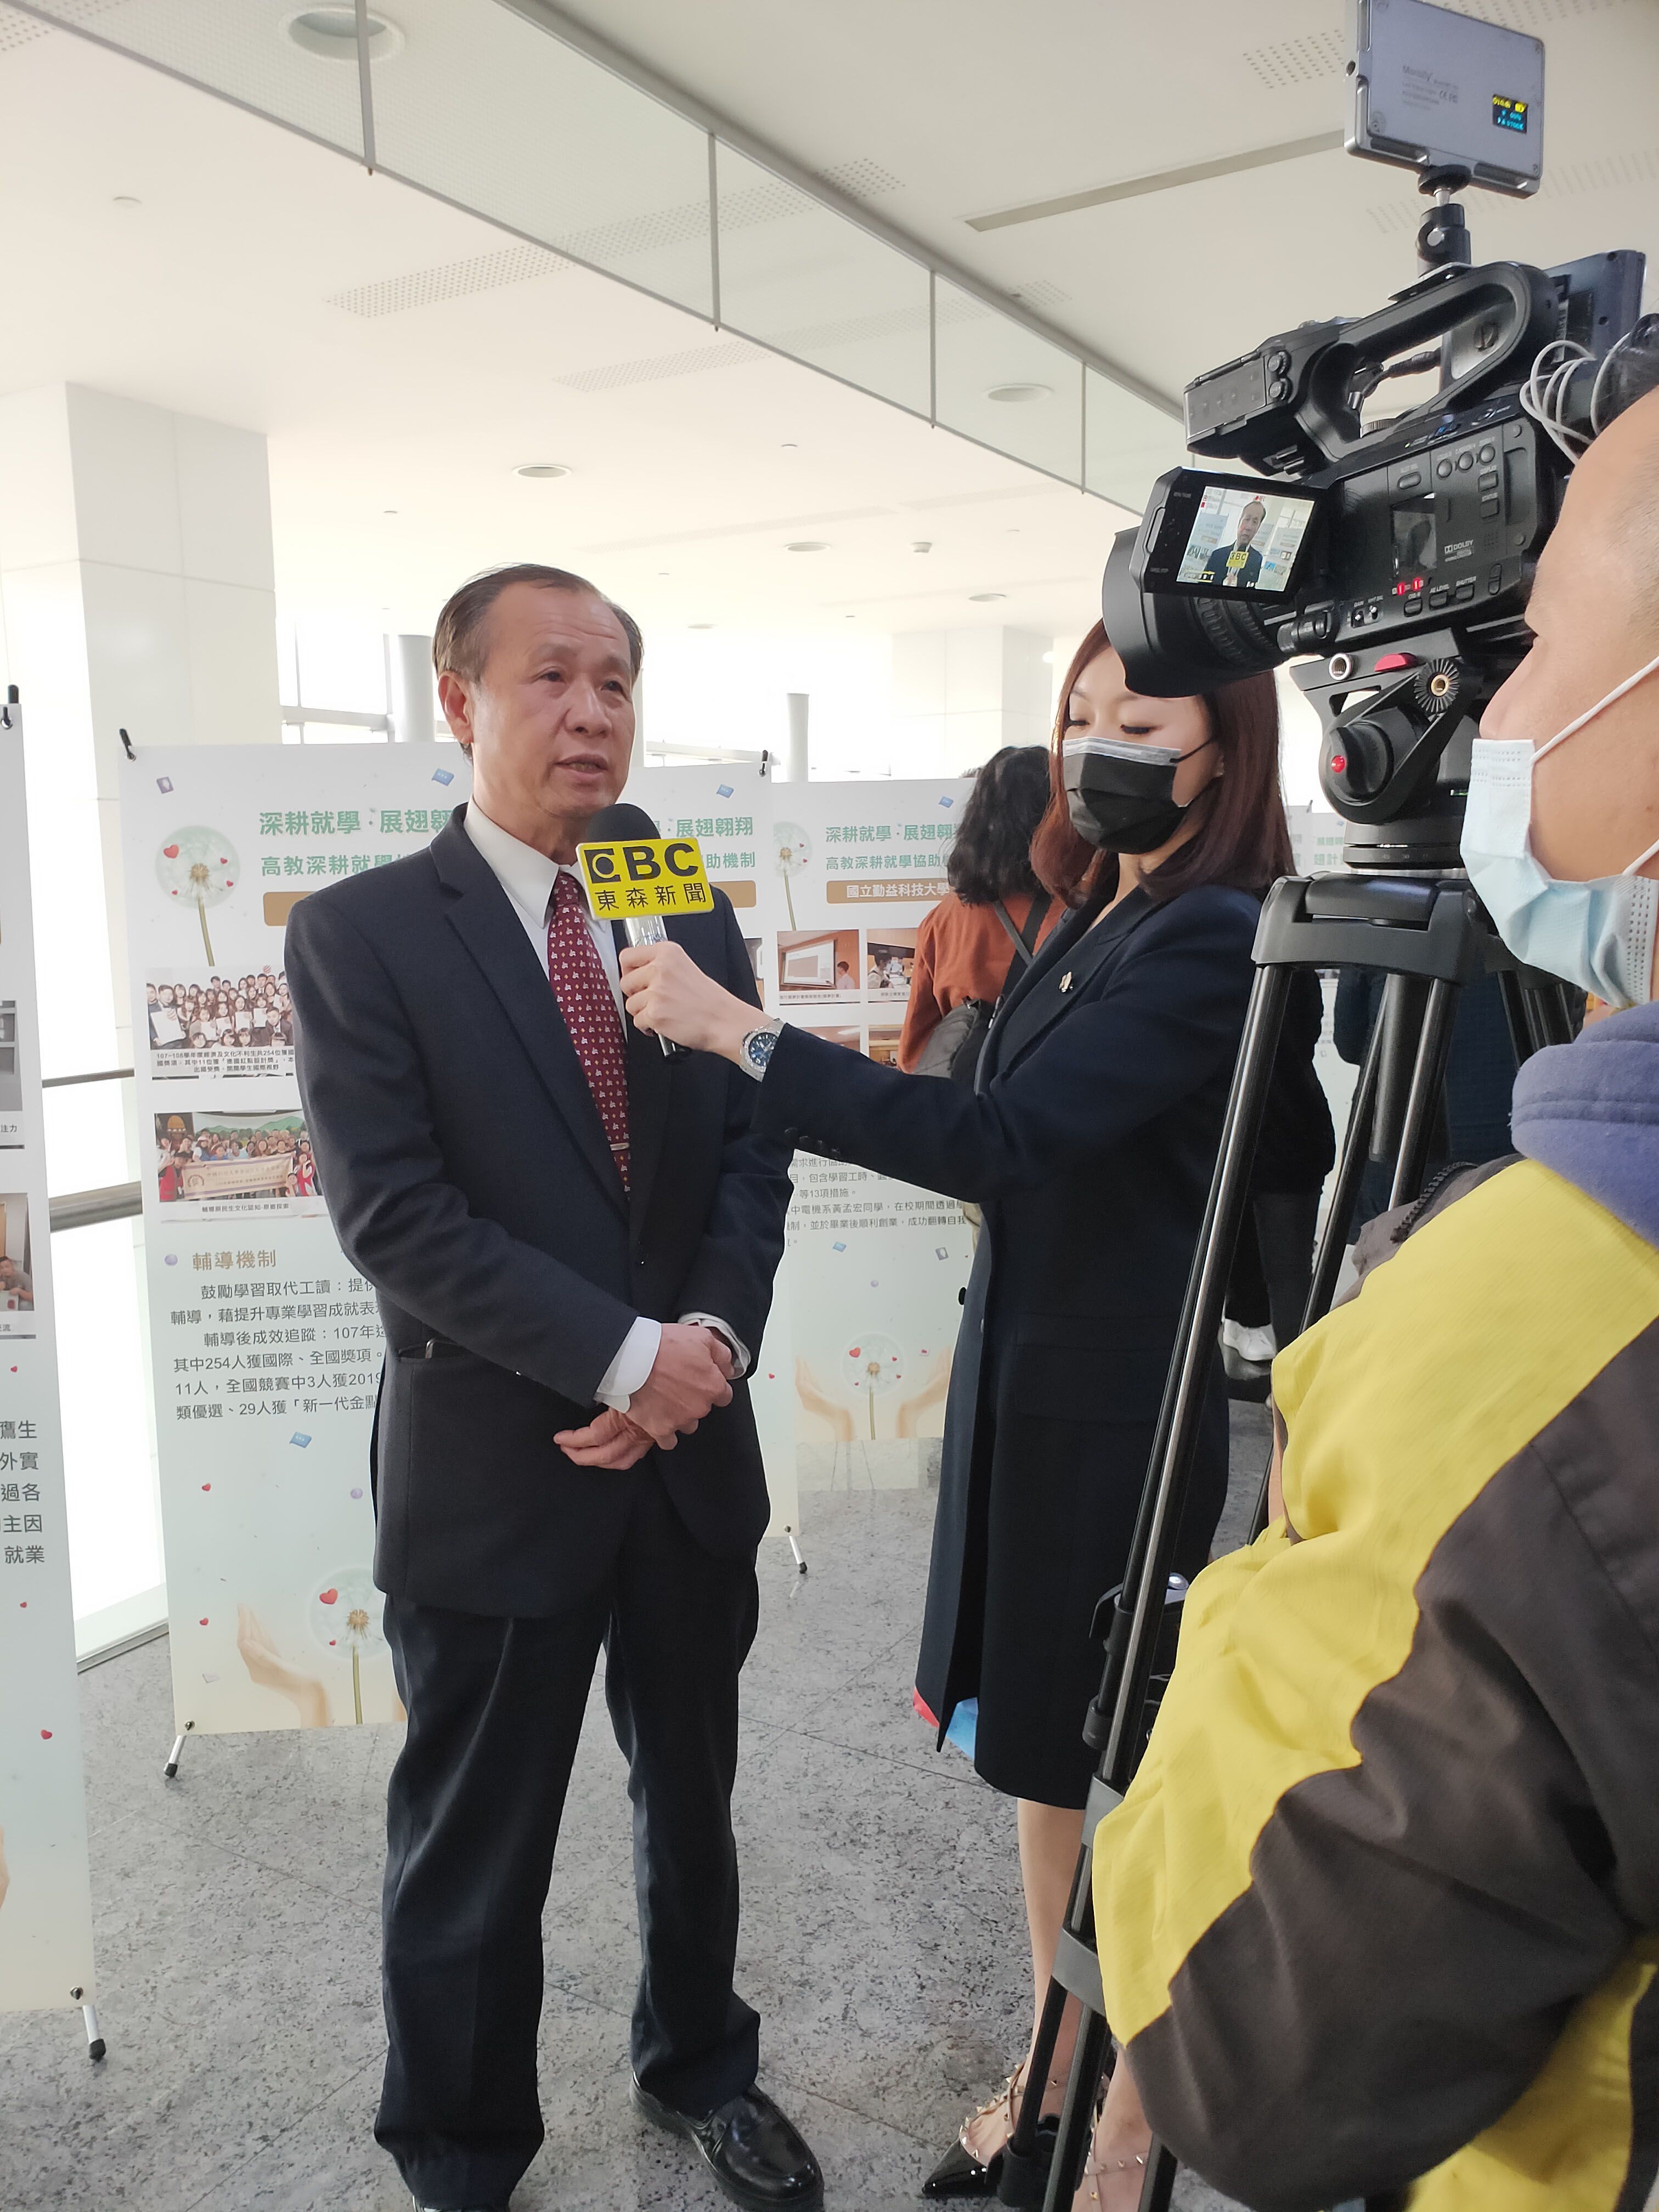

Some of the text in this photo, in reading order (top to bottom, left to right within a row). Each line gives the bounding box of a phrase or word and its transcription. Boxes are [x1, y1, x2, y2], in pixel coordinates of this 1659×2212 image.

[1453, 539, 1474, 550] DOLBY
[261, 854, 404, 876] 高教深耕就學
[594, 883, 707, 911] 東森新聞
[847, 882, 950, 899] 國立勤益科技大學
[787, 1216, 967, 1231] 制，並於畢業後順利創業，成功翻轉自我
[193, 1250, 276, 1271] 輔導機制
[170, 1301, 380, 1325] 輔導，藉提升專業學習成就表
[0, 1452, 38, 1470] 外實
[1, 1483, 40, 1502] 過各
[4, 1545, 45, 1564] 就業
